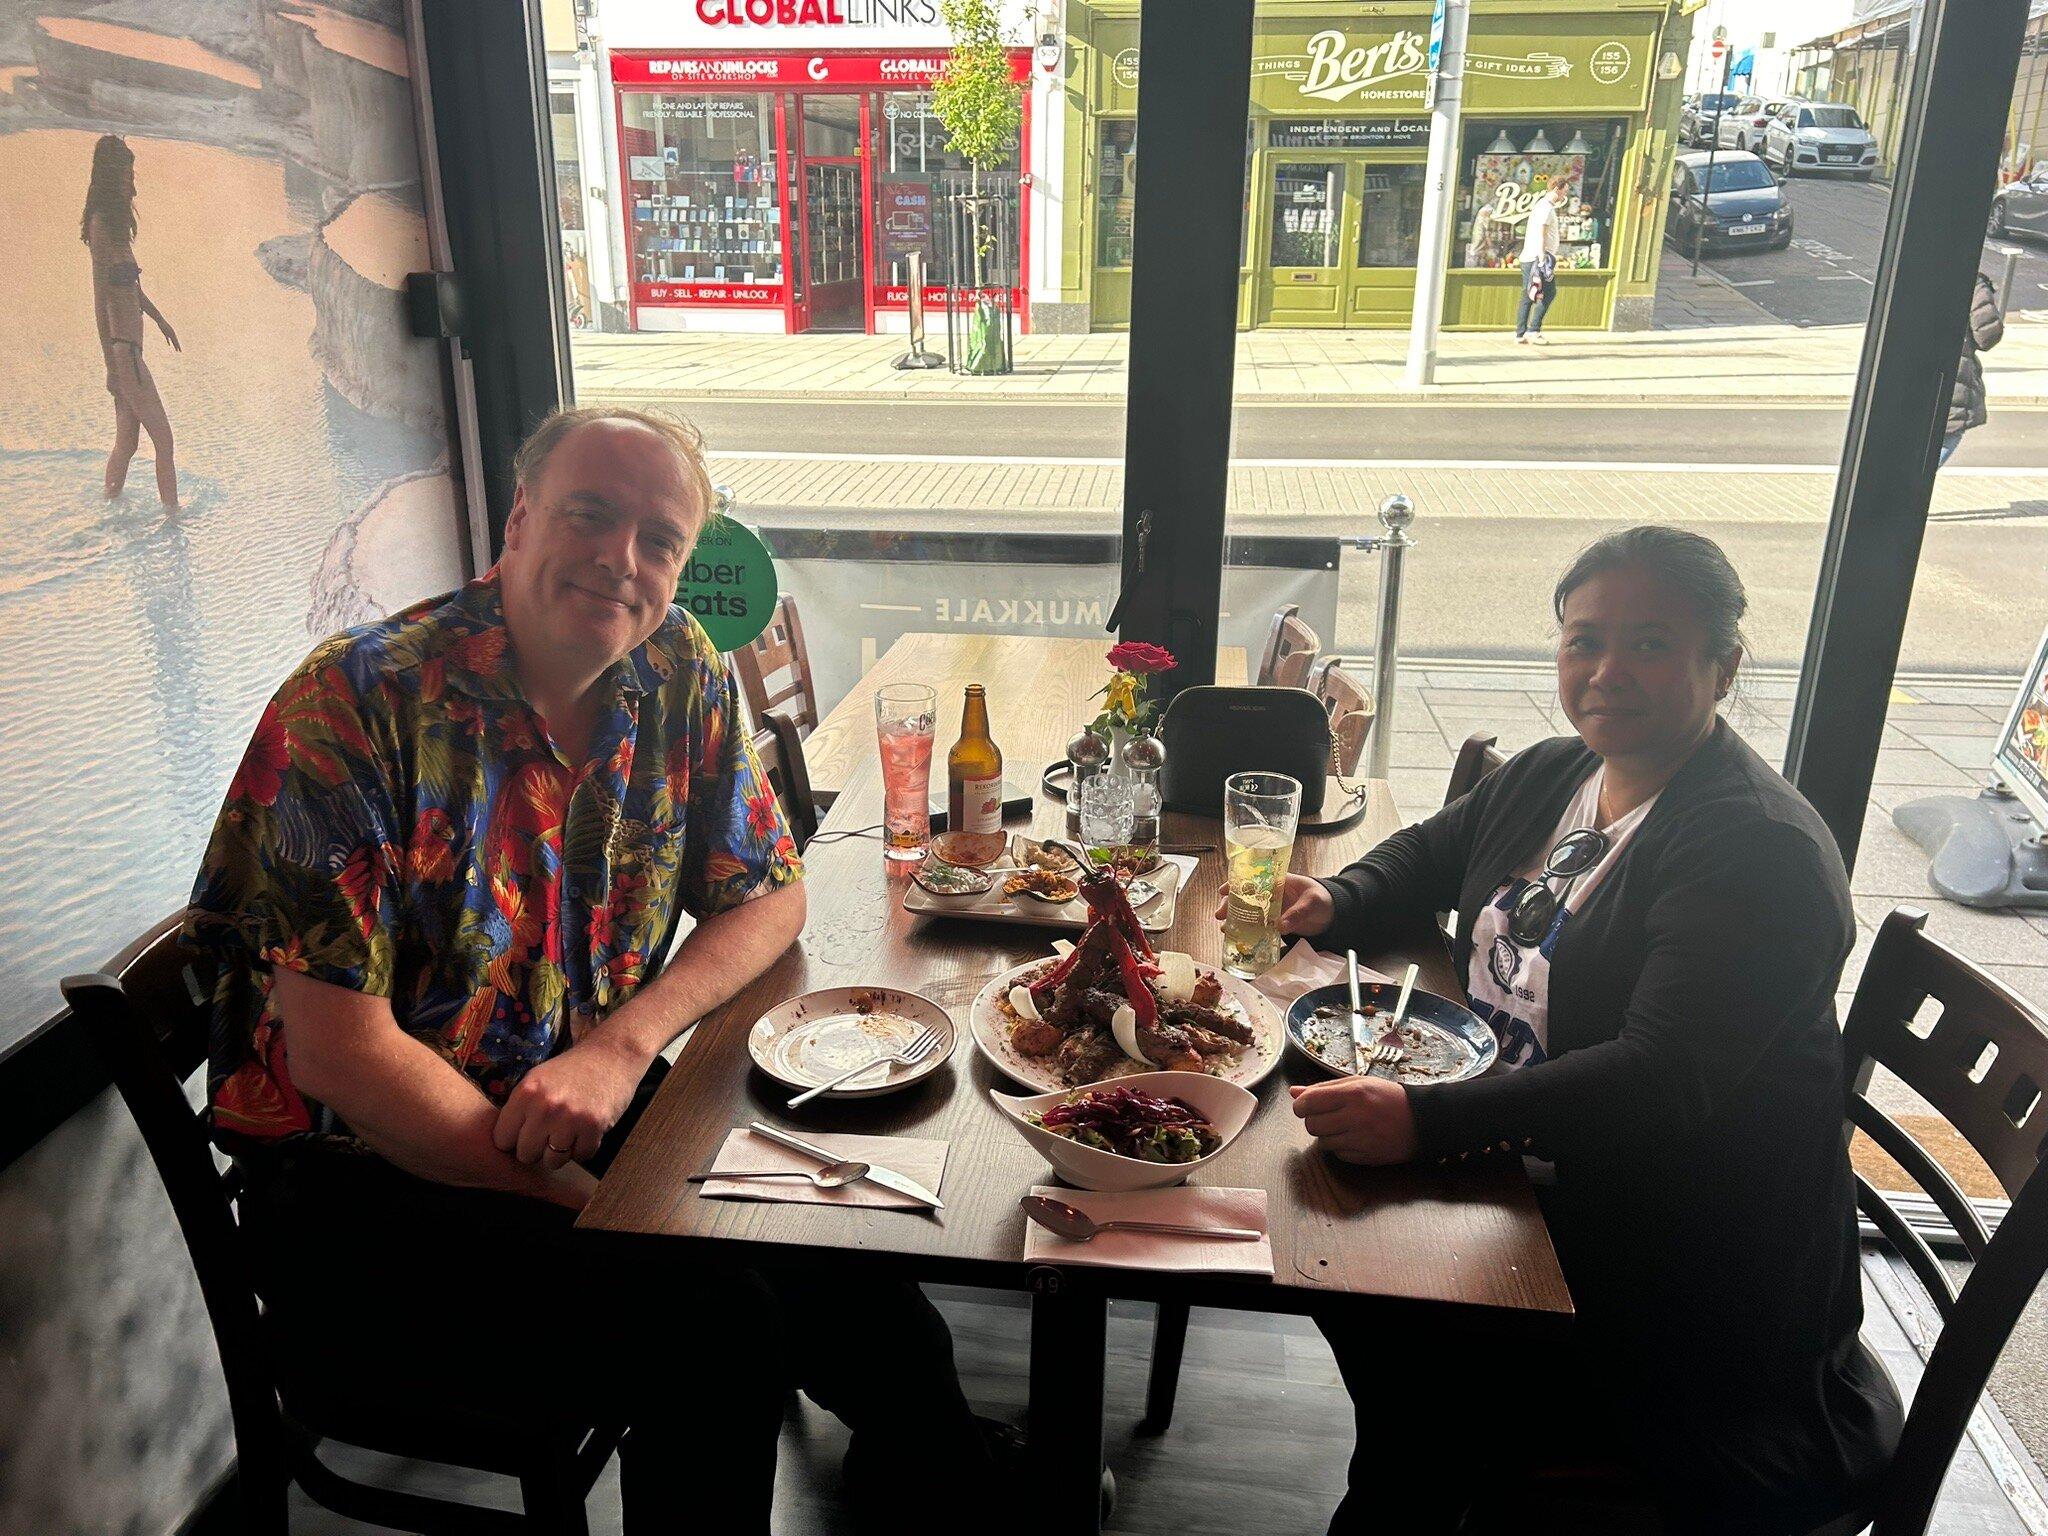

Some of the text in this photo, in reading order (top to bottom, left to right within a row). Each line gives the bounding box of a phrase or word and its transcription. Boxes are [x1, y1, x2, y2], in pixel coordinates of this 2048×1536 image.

[1602, 51, 1620, 60] 155
[1258, 60, 1301, 71] THINGS
[1299, 30, 1425, 95] Bert's
[1475, 61, 1501, 72] GIFT
[1505, 62, 1541, 74] IDEAS
[1600, 65, 1618, 75] 156
[708, 73, 756, 81] WORKSHOP
[880, 72, 918, 80] TRAVEL
[1360, 89, 1426, 100] HOMESTORE
[652, 102, 744, 110] PHONE AND LAPTOP REPAIRS
[643, 110, 671, 118] FRIENDLY
[1290, 125, 1367, 133] INDEPENDENT
[1490, 181, 1550, 220] Ber
[650, 288, 768, 299] BUY SELL REPAIR UNLOCK
[928, 292, 962, 302] HOTLS
[716, 536, 732, 546] ON
[1515, 984, 1536, 1003] 1992
